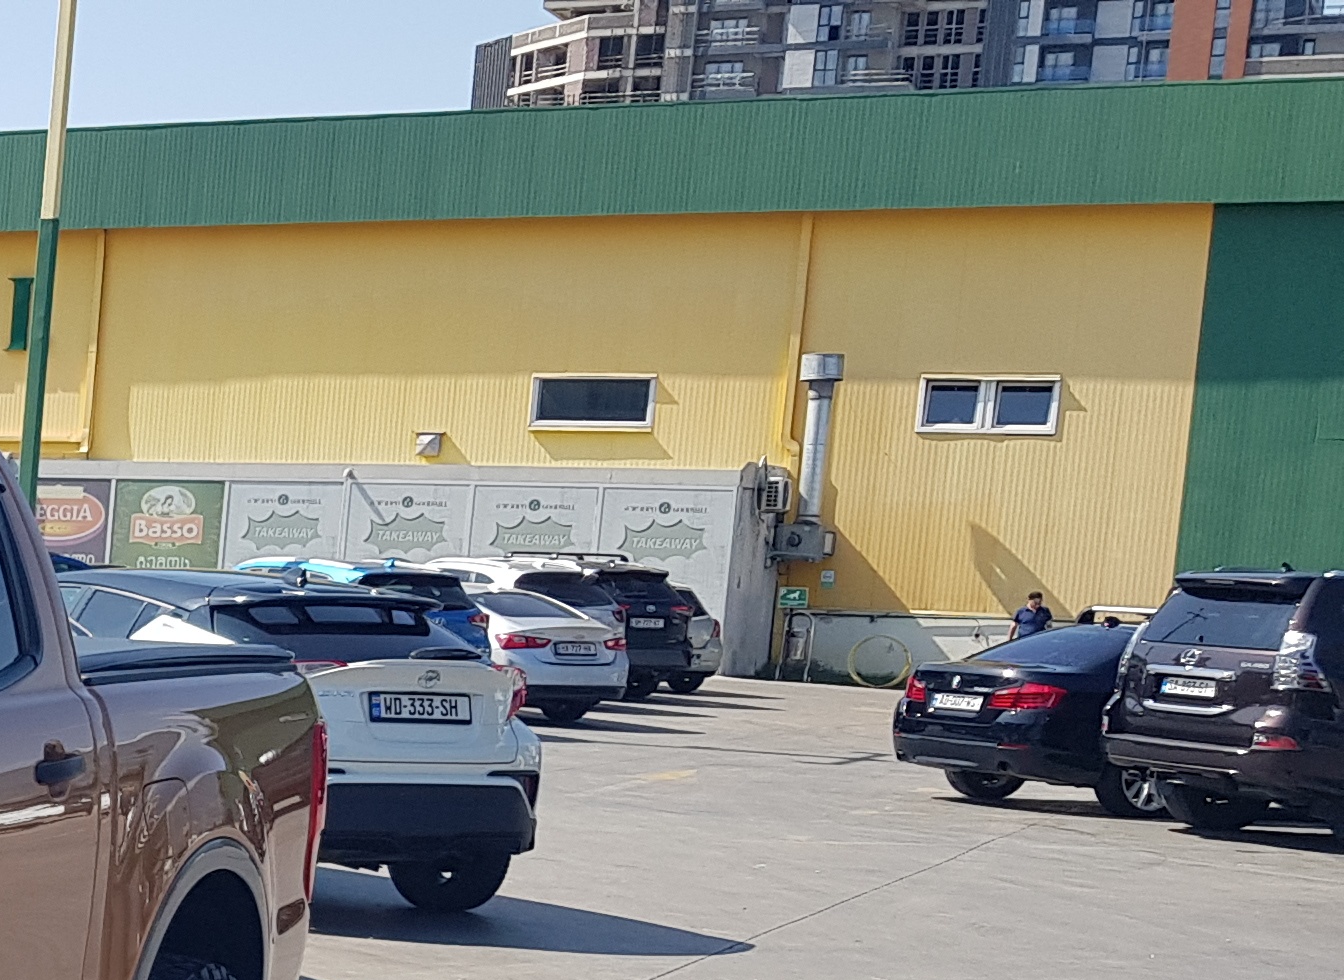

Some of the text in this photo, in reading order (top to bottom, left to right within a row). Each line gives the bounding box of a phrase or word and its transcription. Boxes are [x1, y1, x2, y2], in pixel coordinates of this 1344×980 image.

[134, 519, 198, 538] Basso
[254, 526, 315, 538] TAKEAWAY
[377, 530, 440, 543] TAKEAWAY
[502, 532, 569, 546] TAKEAWAY
[631, 536, 701, 549] TAKEAWAY
[383, 696, 459, 717] WD-333-SH
